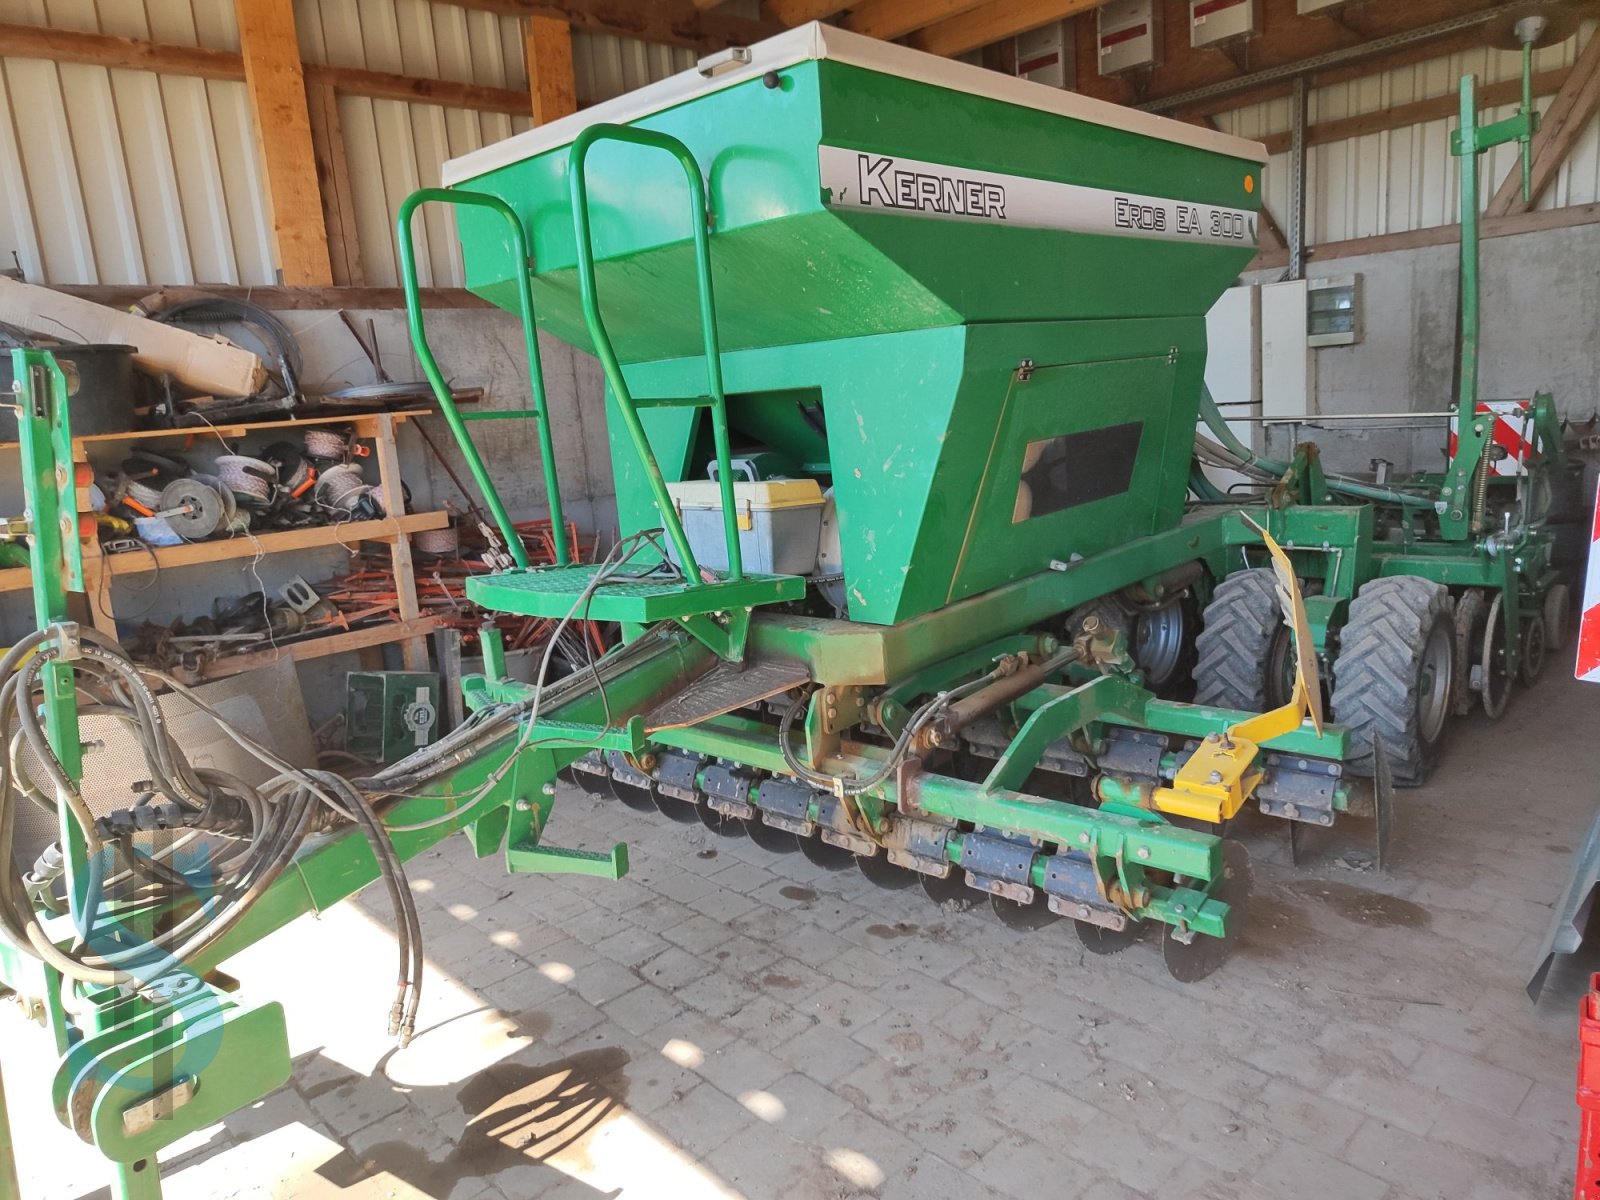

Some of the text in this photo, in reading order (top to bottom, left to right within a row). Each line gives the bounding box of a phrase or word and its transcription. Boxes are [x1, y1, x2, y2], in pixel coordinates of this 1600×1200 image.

[858, 154, 1006, 219] KERNER
[1114, 197, 1244, 239] EROS EA 300
